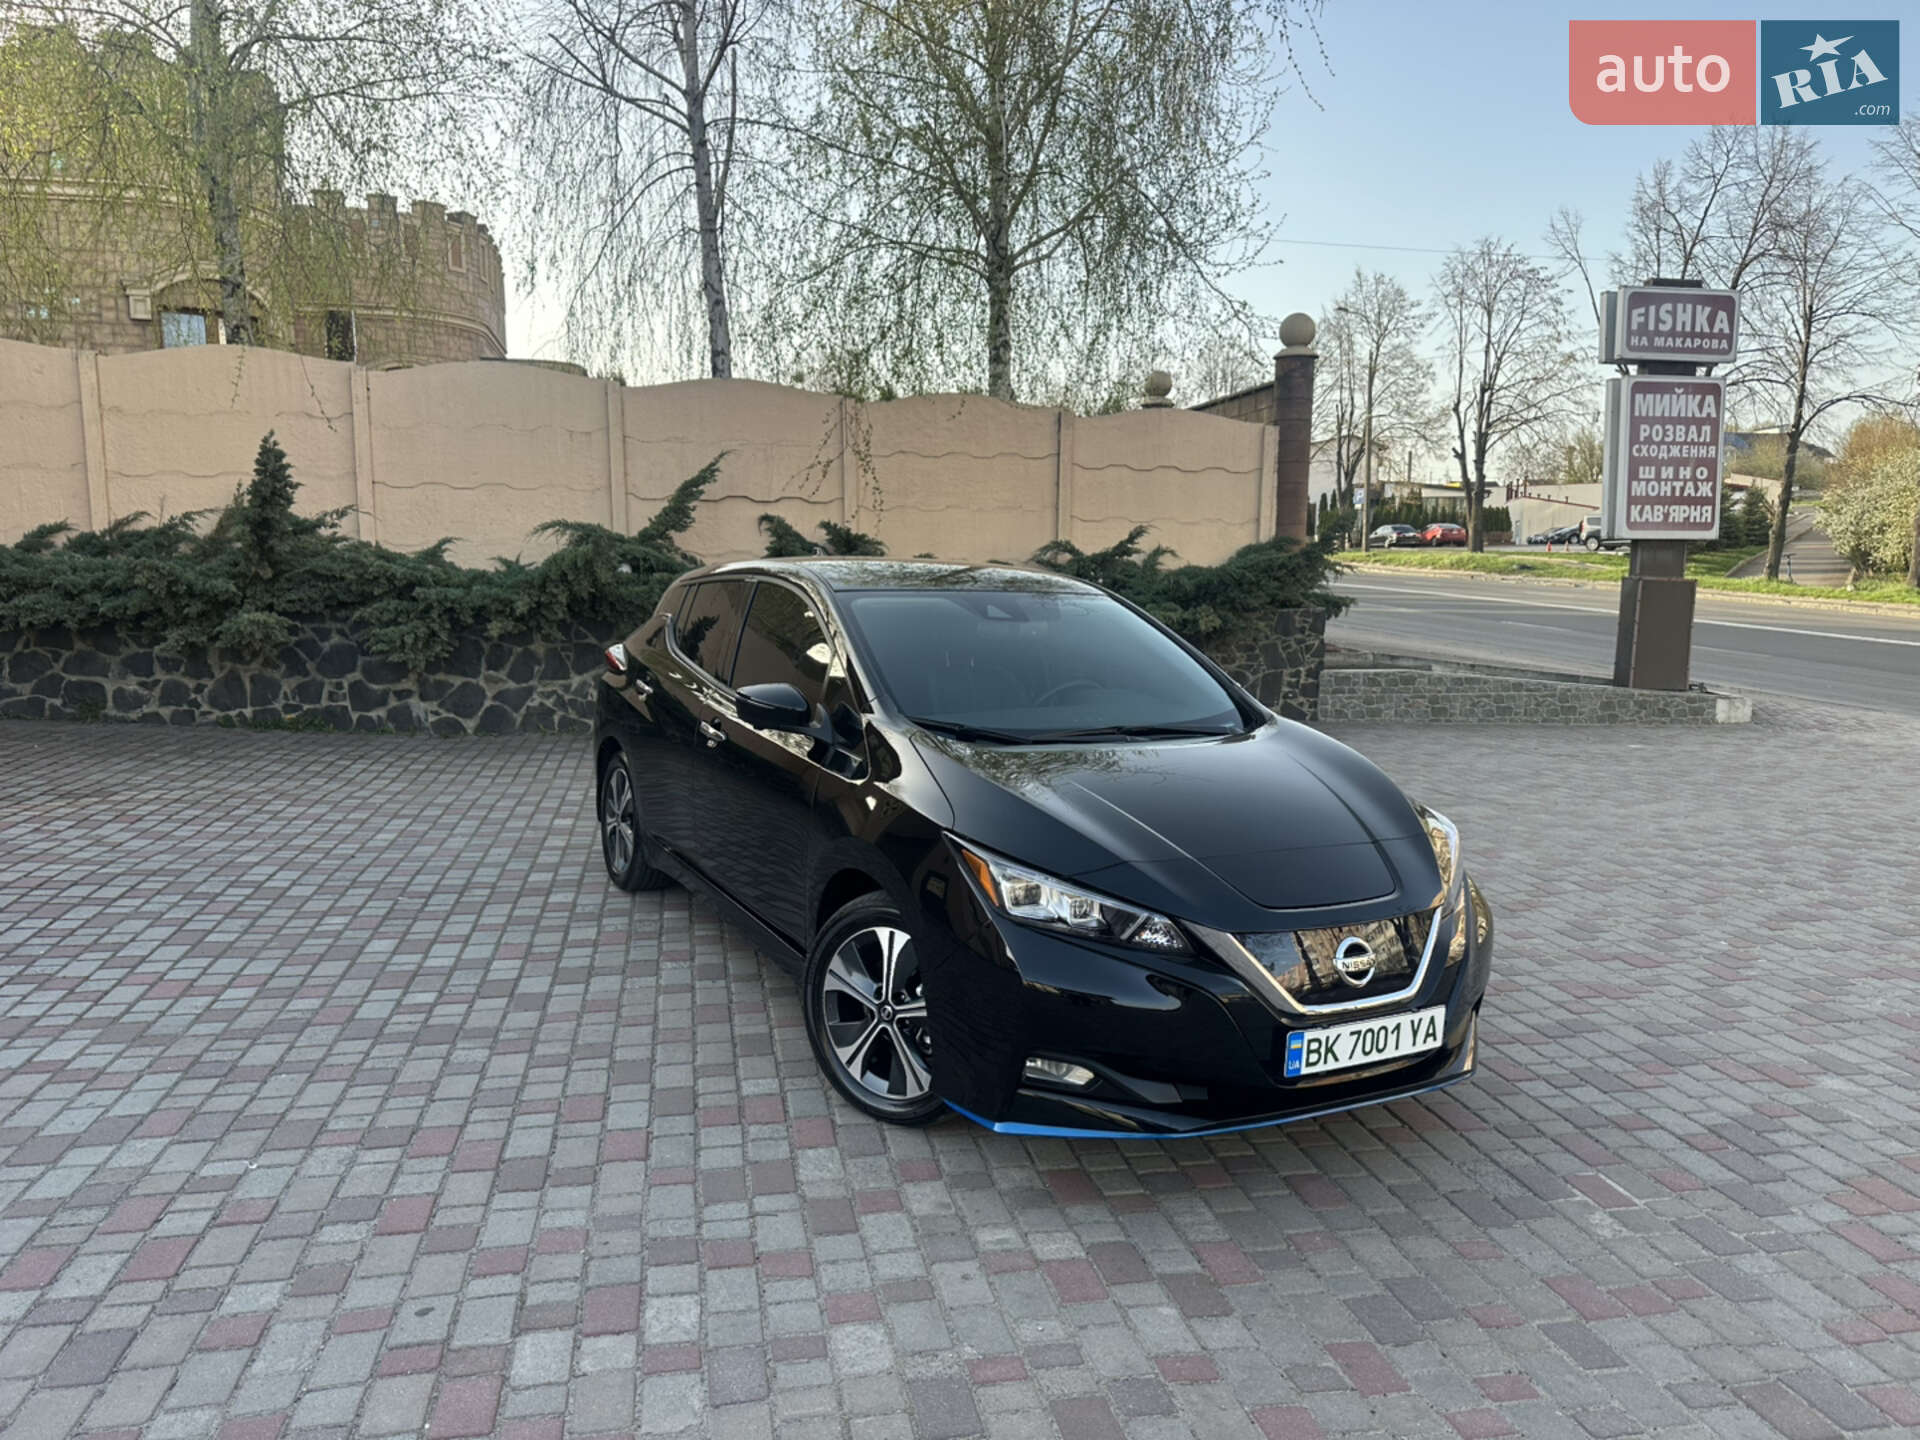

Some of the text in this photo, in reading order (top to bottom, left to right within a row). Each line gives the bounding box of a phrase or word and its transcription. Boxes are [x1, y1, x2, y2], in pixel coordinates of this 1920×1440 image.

[1631, 303, 1730, 335] FISHKA
[1631, 336, 1729, 350] НА МАКАРОВА
[1634, 388, 1718, 418] МИЙКА
[1639, 424, 1712, 442] РОЗВАЛ
[1632, 444, 1717, 460] СХОДЖЕННЯ
[1631, 481, 1713, 497] МОНТАЖ
[1305, 1015, 1438, 1068] BK 7001 YA
